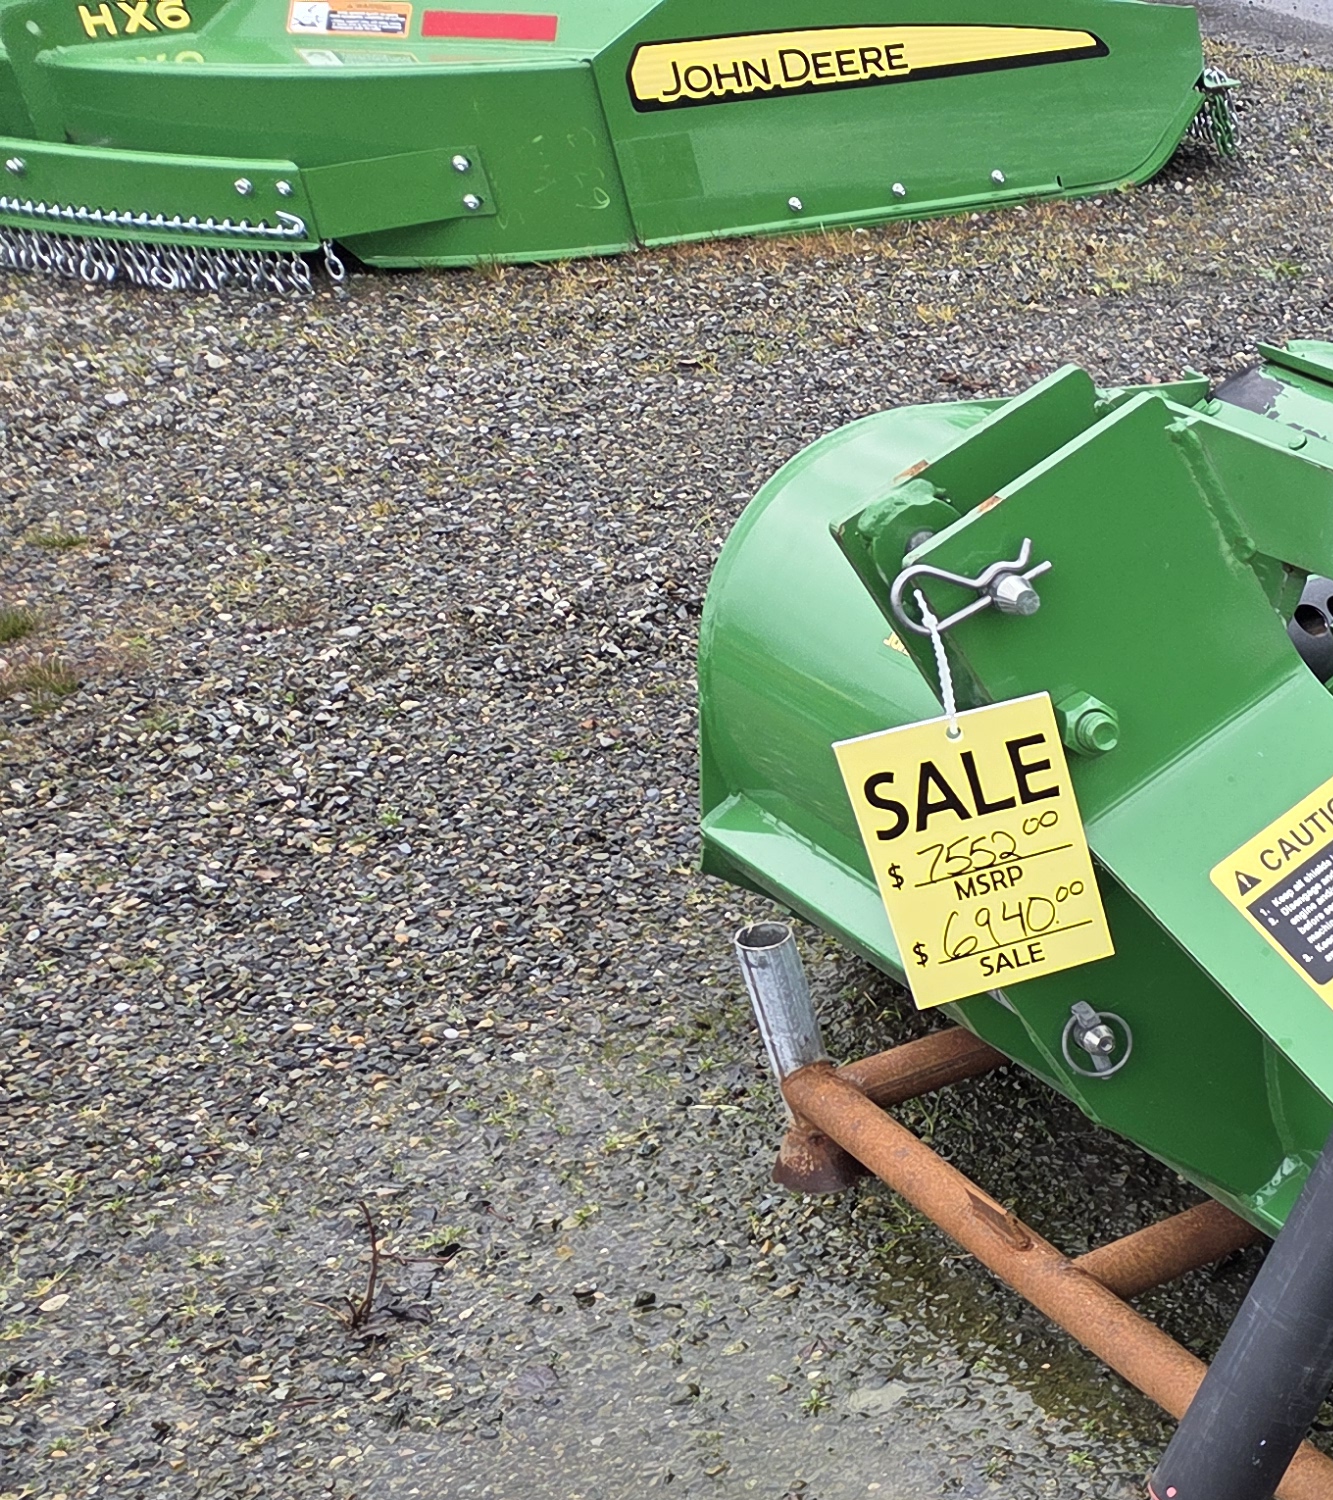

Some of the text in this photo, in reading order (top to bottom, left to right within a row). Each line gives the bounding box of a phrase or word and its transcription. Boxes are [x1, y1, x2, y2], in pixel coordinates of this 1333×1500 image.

[79, 0, 191, 37] HX6
[662, 43, 909, 97] JOHN DEERE
[863, 733, 1060, 841] SALE
[888, 862, 905, 890] $
[954, 865, 1023, 901] MSRP
[913, 941, 929, 967] $
[979, 942, 1046, 977] SALE
